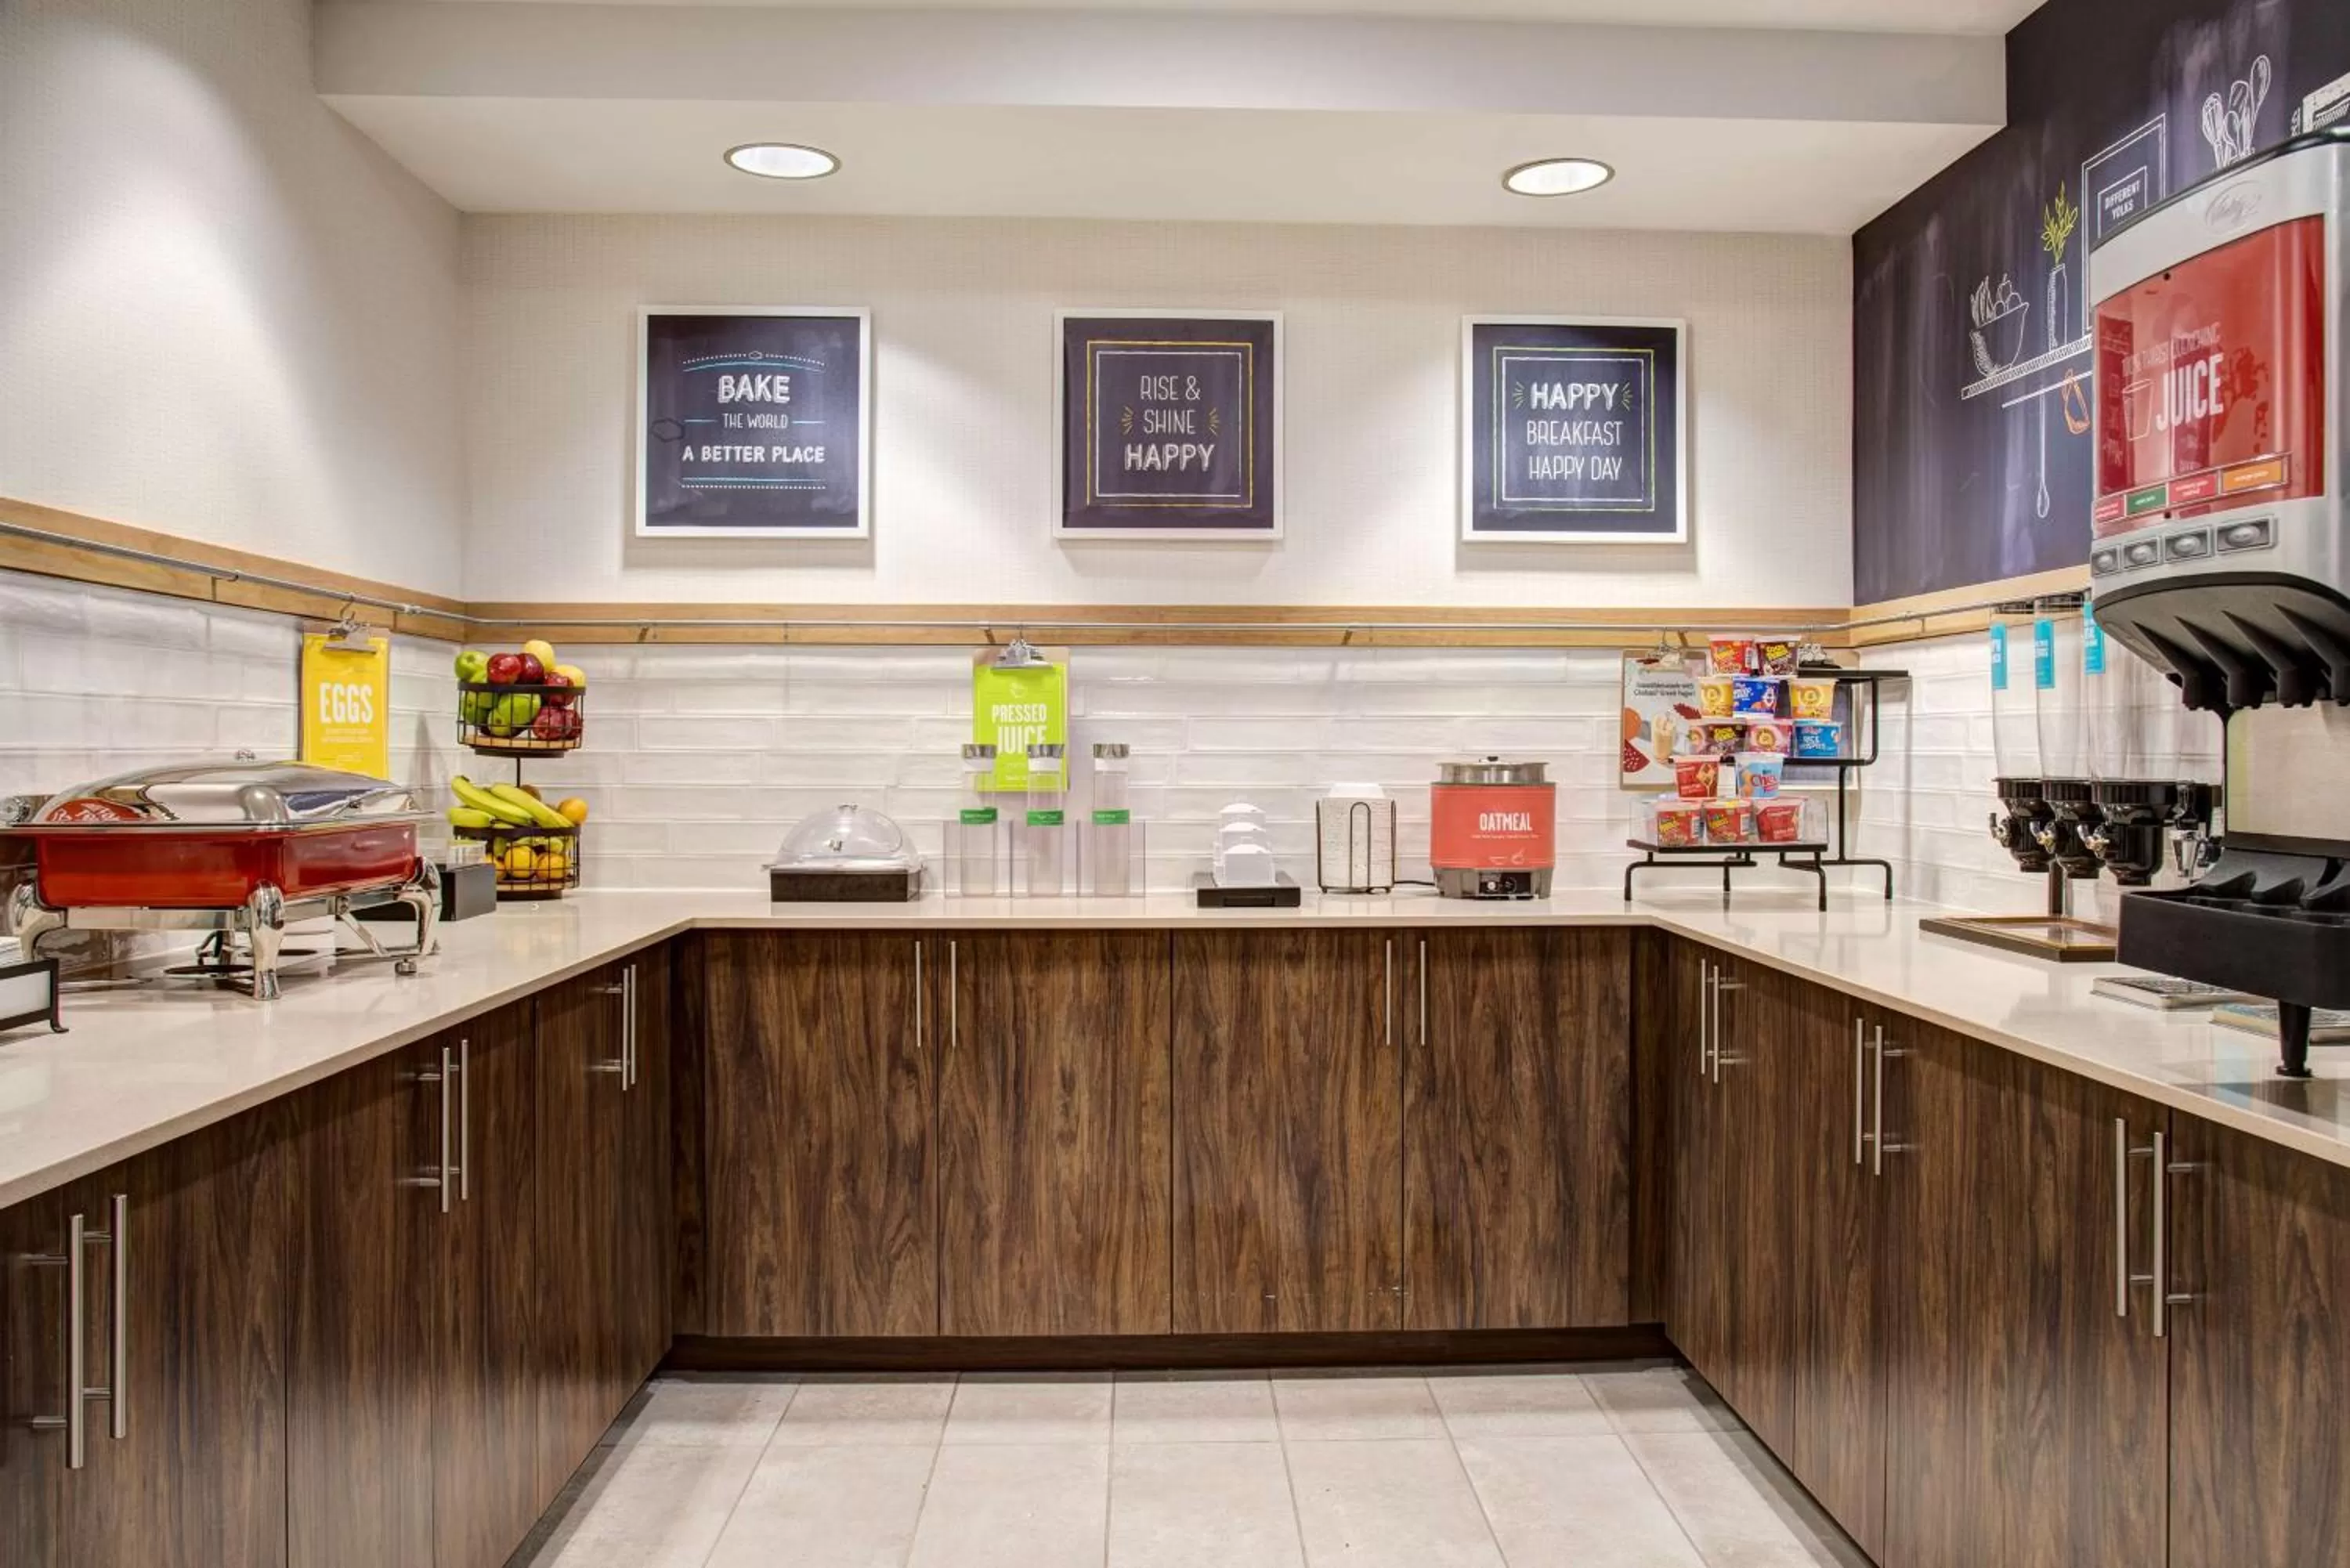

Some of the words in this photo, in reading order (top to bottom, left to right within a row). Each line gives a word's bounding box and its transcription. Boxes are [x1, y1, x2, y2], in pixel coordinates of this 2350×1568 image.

[2105, 180, 2140, 210] DIFFERENT
[718, 374, 790, 403] BAKE
[1141, 375, 1178, 400] RISE
[1185, 375, 1201, 400] &
[1531, 381, 1618, 411] HAPPY
[2156, 352, 2224, 431] JUICE
[723, 413, 743, 428] THE
[747, 413, 789, 429] WORLD
[1143, 409, 1196, 435] SHINE
[1527, 421, 1623, 446] BREAKFAST
[682, 445, 694, 462] A
[701, 445, 765, 463] BETTER
[772, 446, 826, 464] PLACE
[1124, 443, 1215, 471] HAPPY
[1529, 455, 1585, 480] HAPPY
[1591, 456, 1622, 480] DAY
[319, 681, 374, 724] EGGS
[992, 703, 1047, 724] PRESSED
[997, 725, 1047, 754] JUICE
[1479, 812, 1533, 831] OATMEAL
